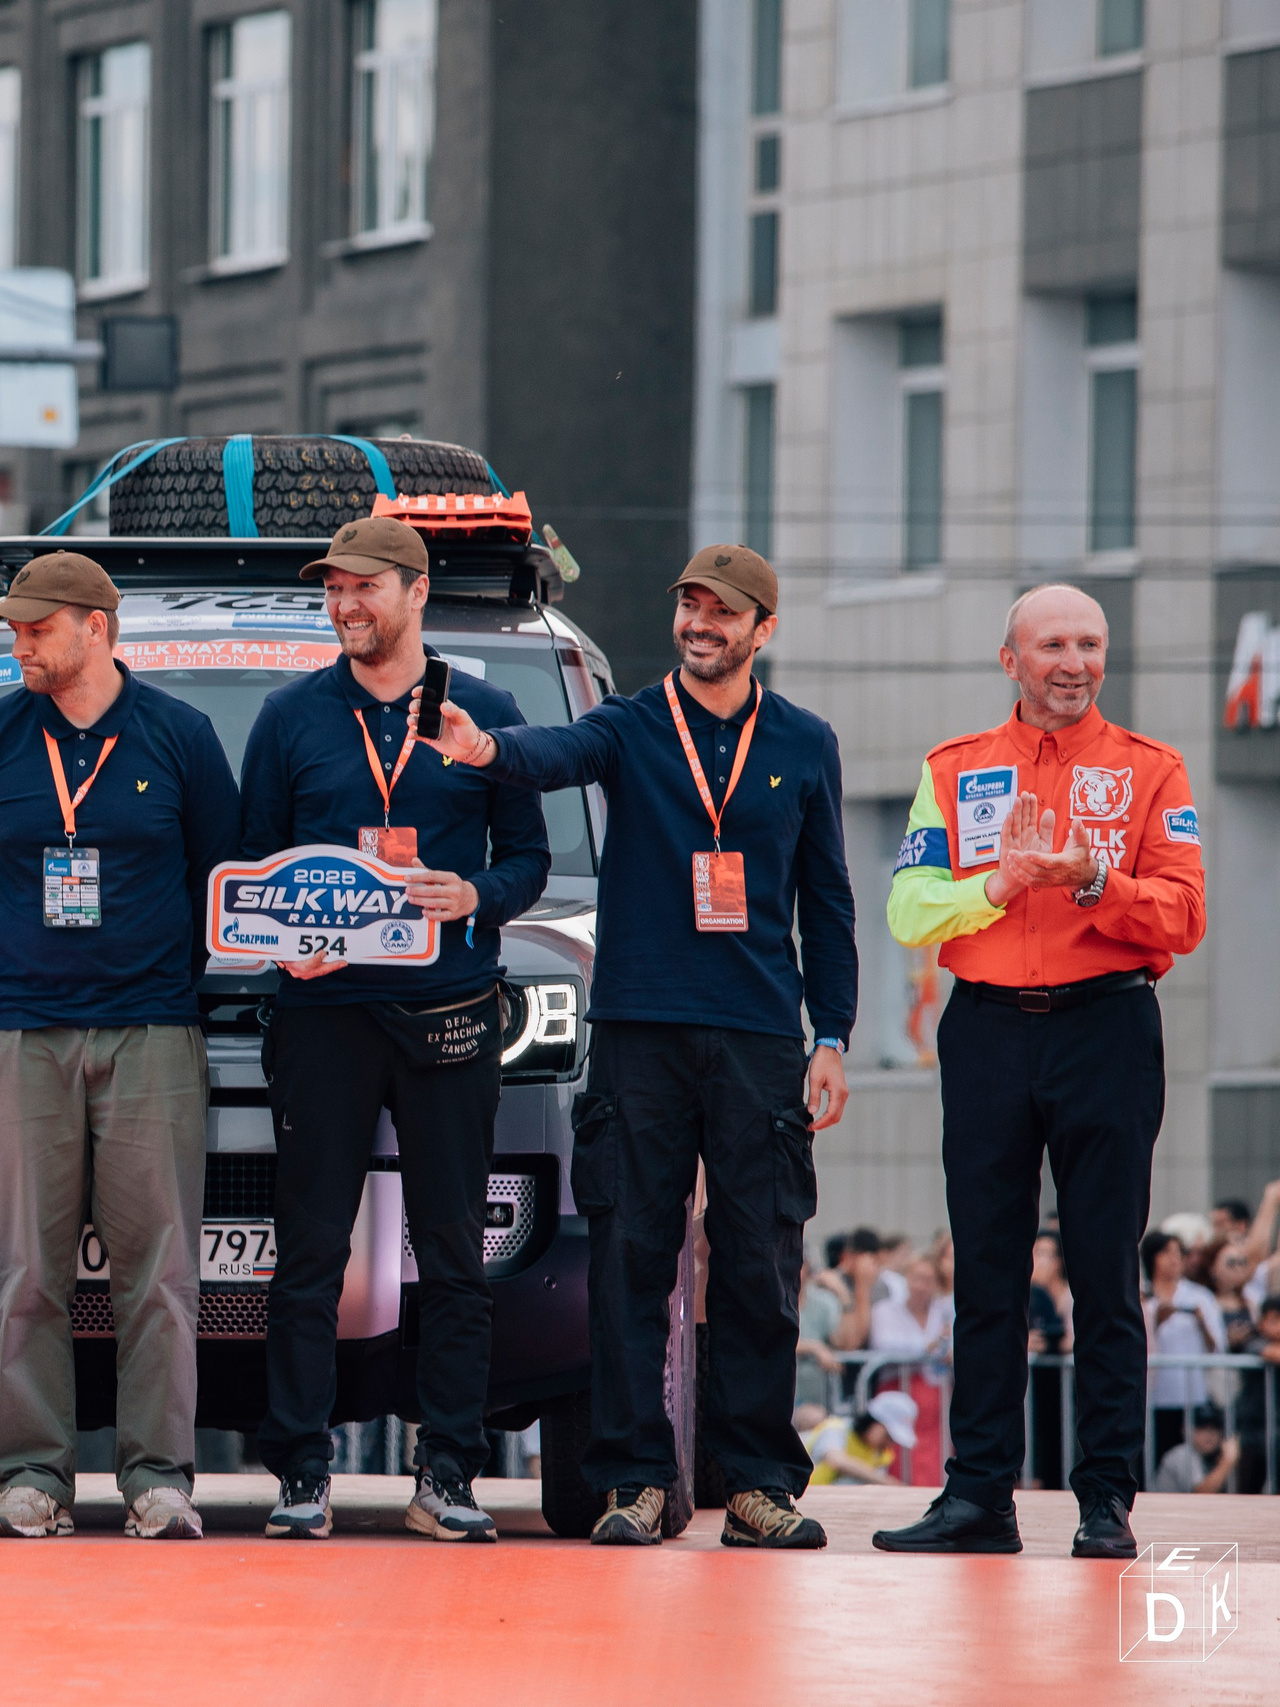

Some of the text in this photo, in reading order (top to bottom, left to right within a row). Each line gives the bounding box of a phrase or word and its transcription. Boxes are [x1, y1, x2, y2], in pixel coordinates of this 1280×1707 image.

[123, 643, 302, 657] SILK WAY RALLY
[129, 656, 159, 668] 15th
[169, 654, 247, 666] EDITION
[1069, 828, 1127, 849] ILK
[294, 868, 356, 885] 2025
[233, 884, 409, 914] SILK WAY
[288, 913, 359, 926] RALLY
[700, 917, 744, 925] ORGANIZATION
[239, 933, 279, 946] GAZPROM
[298, 934, 347, 956] 524
[428, 1033, 440, 1043] EX
[445, 1022, 487, 1041] MACHINA
[203, 1229, 270, 1262] 797
[219, 1263, 251, 1275] RUS
